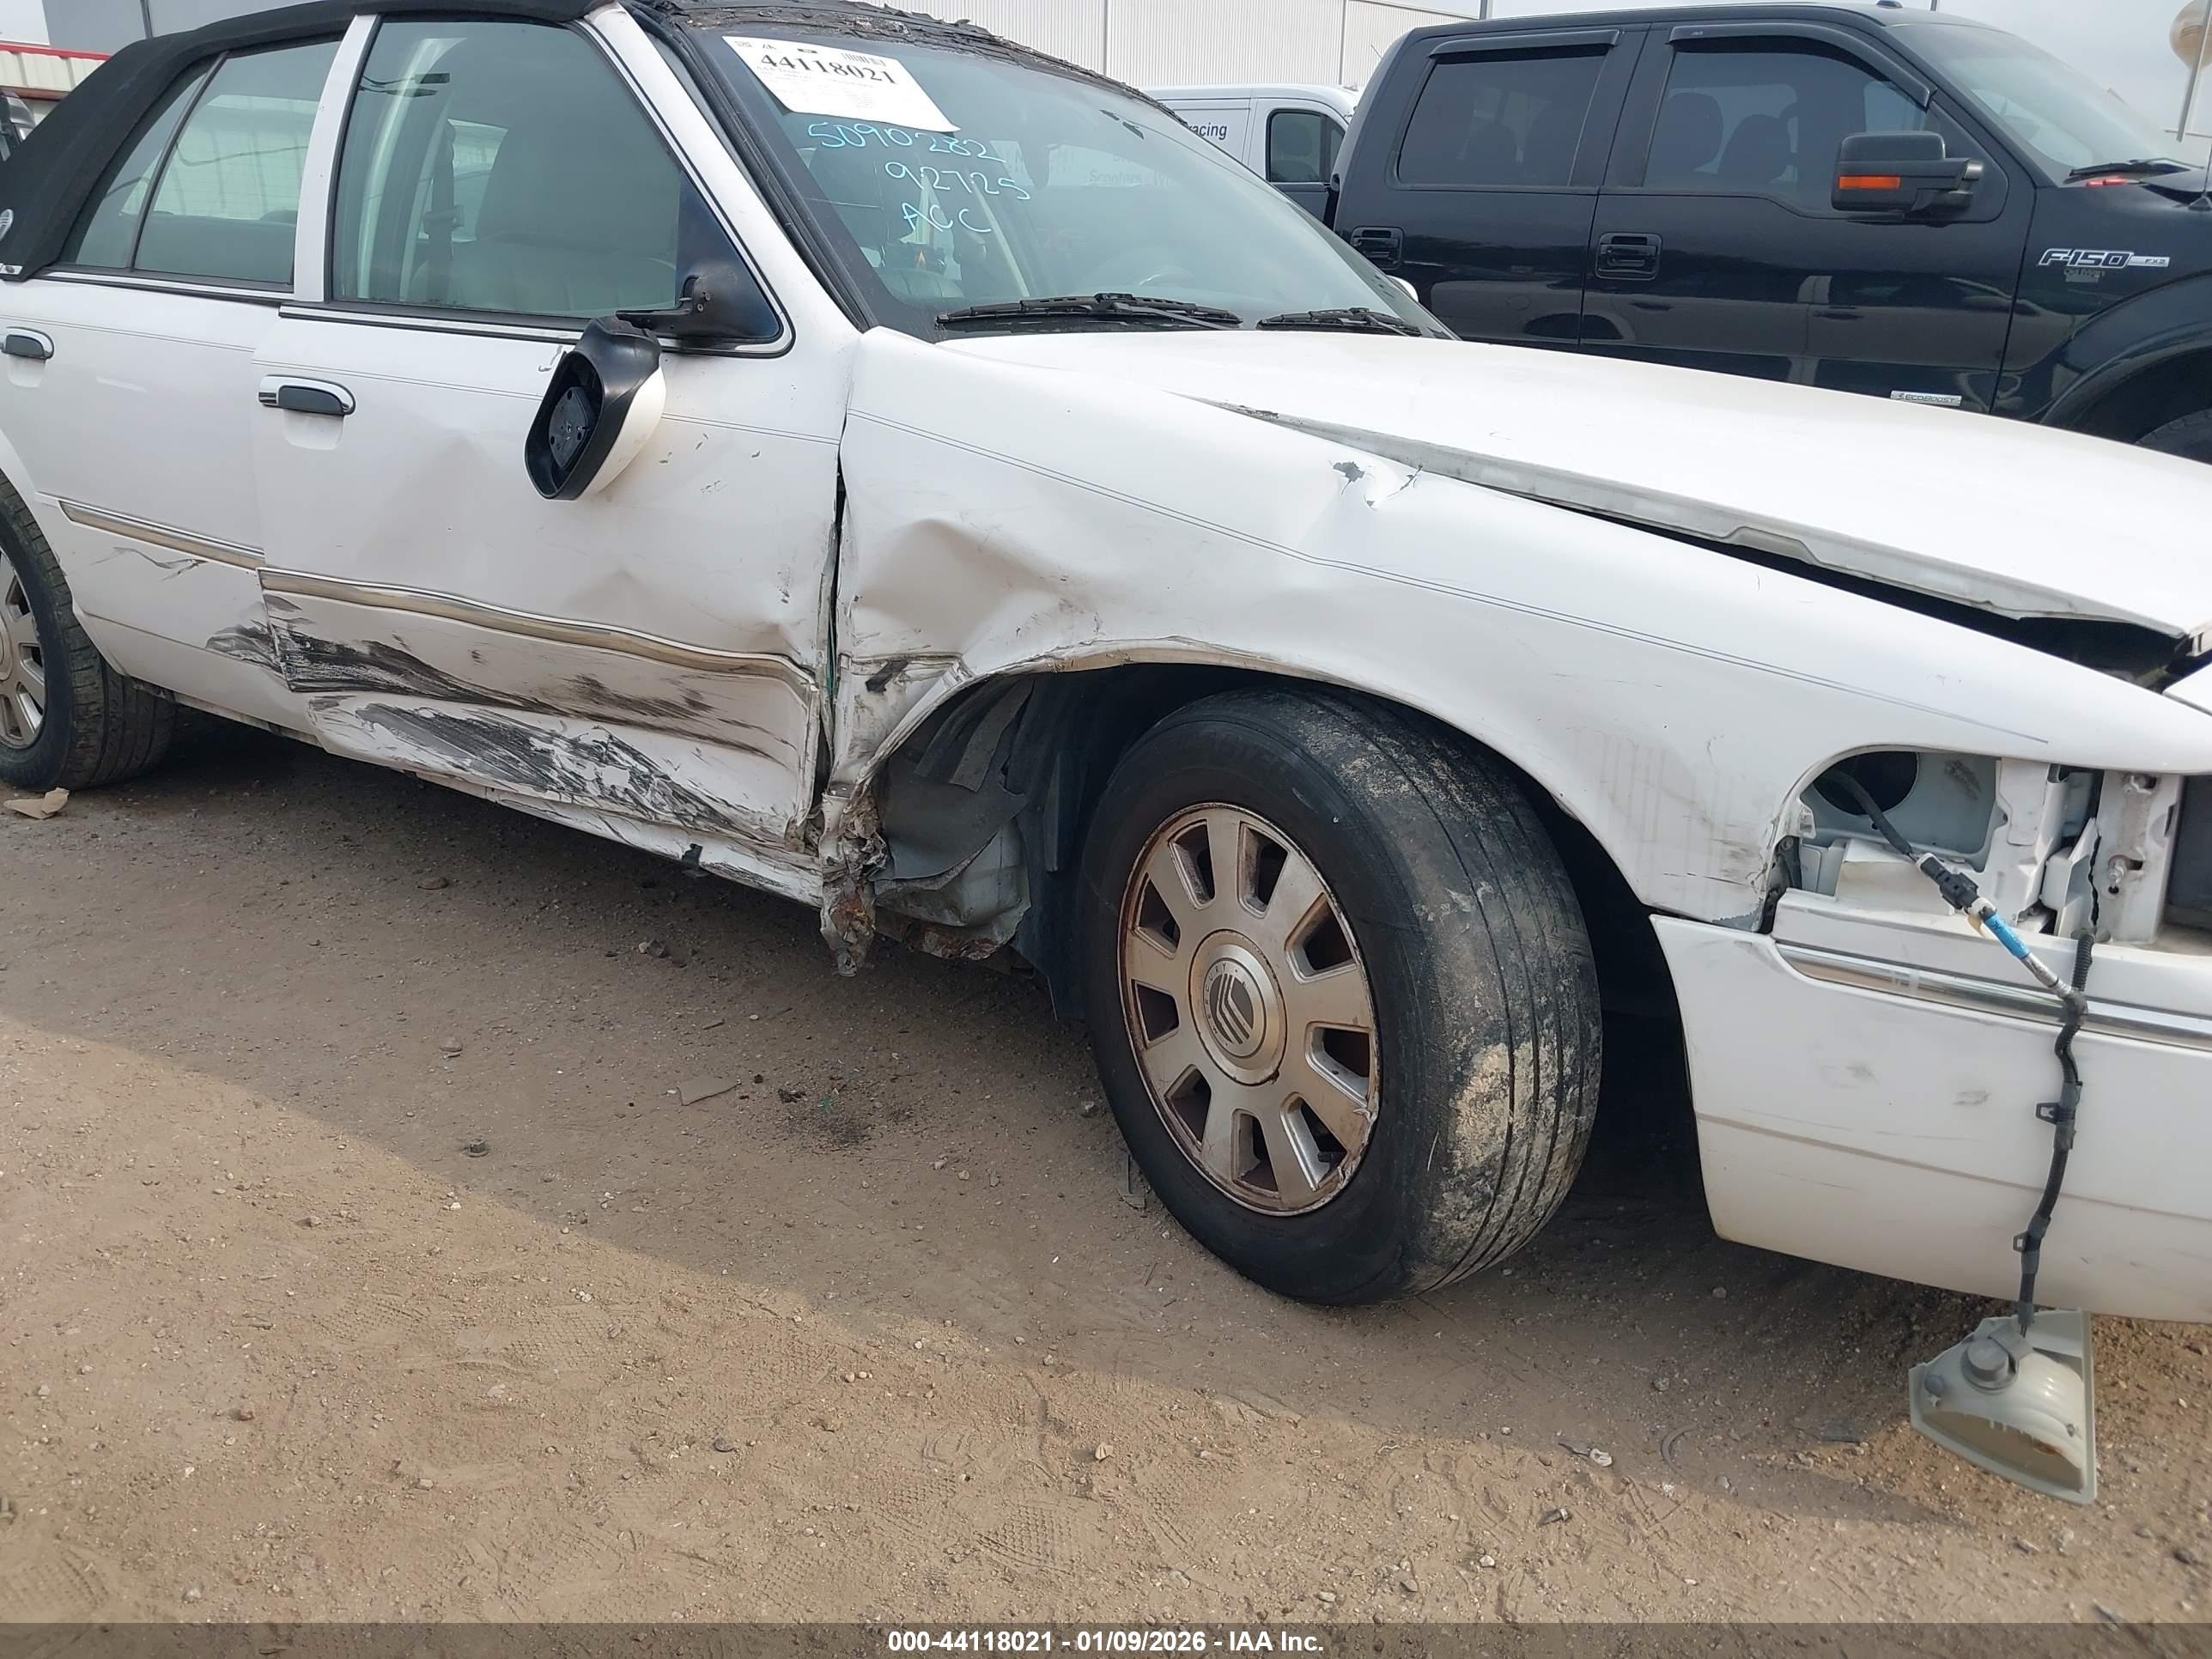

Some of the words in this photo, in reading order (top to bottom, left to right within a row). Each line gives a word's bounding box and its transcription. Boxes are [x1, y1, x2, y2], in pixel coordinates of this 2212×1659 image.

[761, 54, 898, 85] 44118021
[902, 202, 993, 234] ACC
[2037, 247, 2135, 270] F-150
